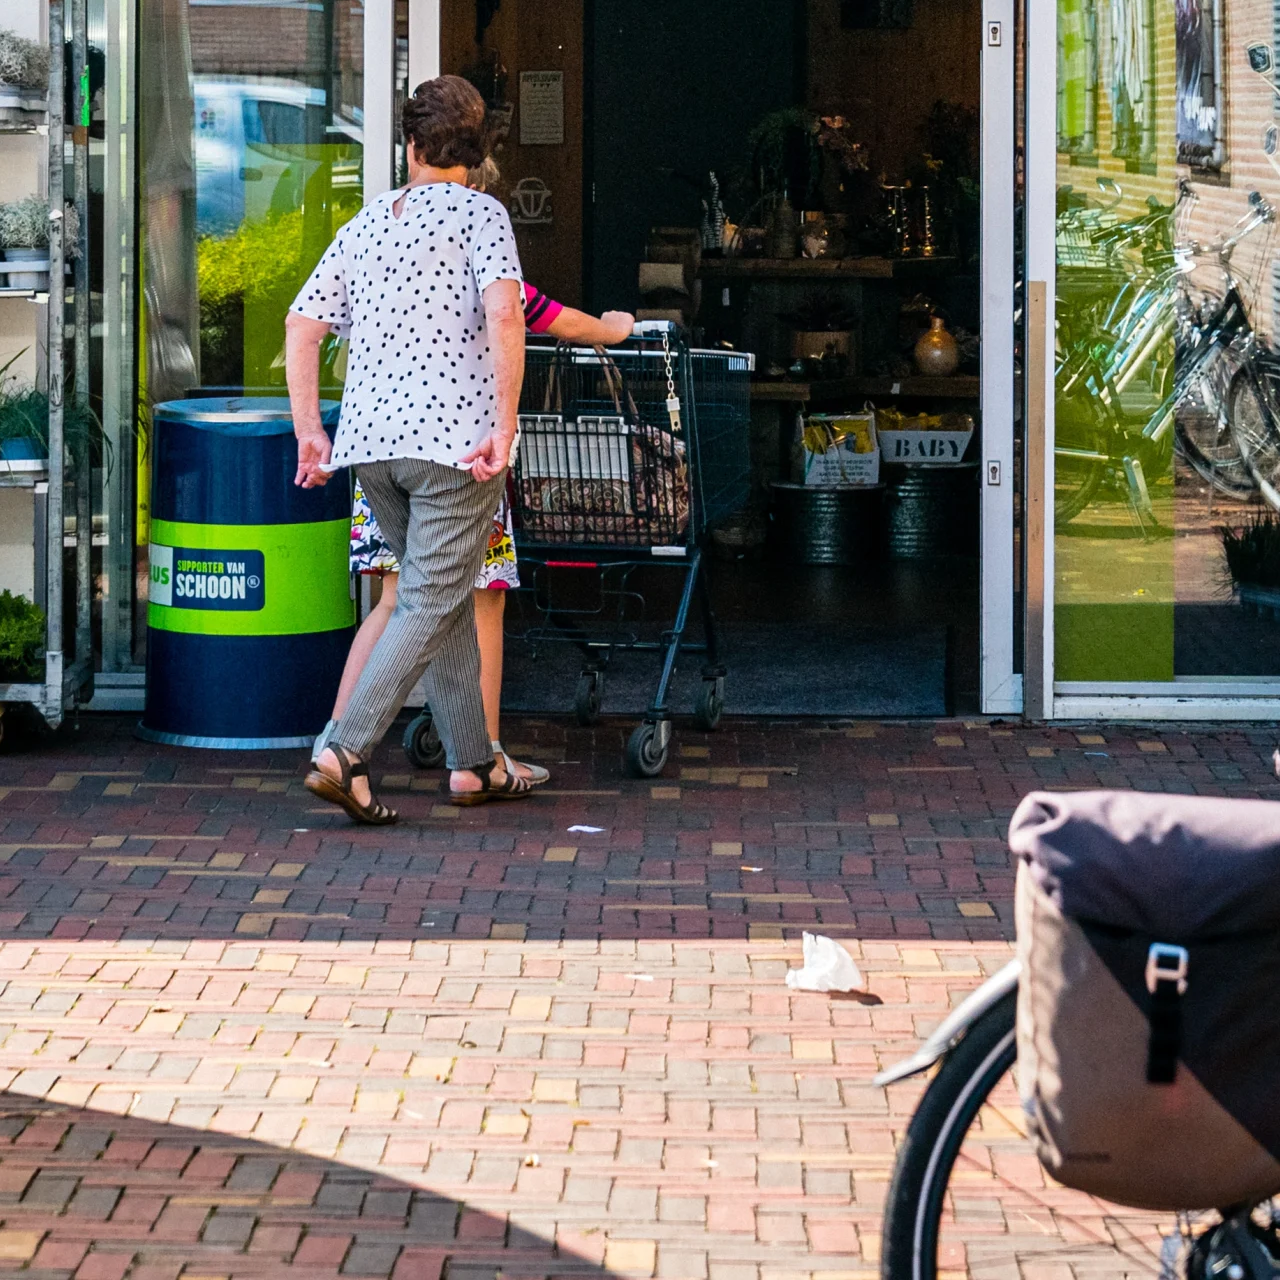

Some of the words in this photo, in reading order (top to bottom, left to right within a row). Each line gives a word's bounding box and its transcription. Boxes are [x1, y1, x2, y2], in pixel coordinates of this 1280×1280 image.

[894, 438, 965, 459] BABY
[177, 560, 224, 574] SUPPORTER
[226, 562, 245, 574] VAN
[175, 573, 246, 600] SCHOON
